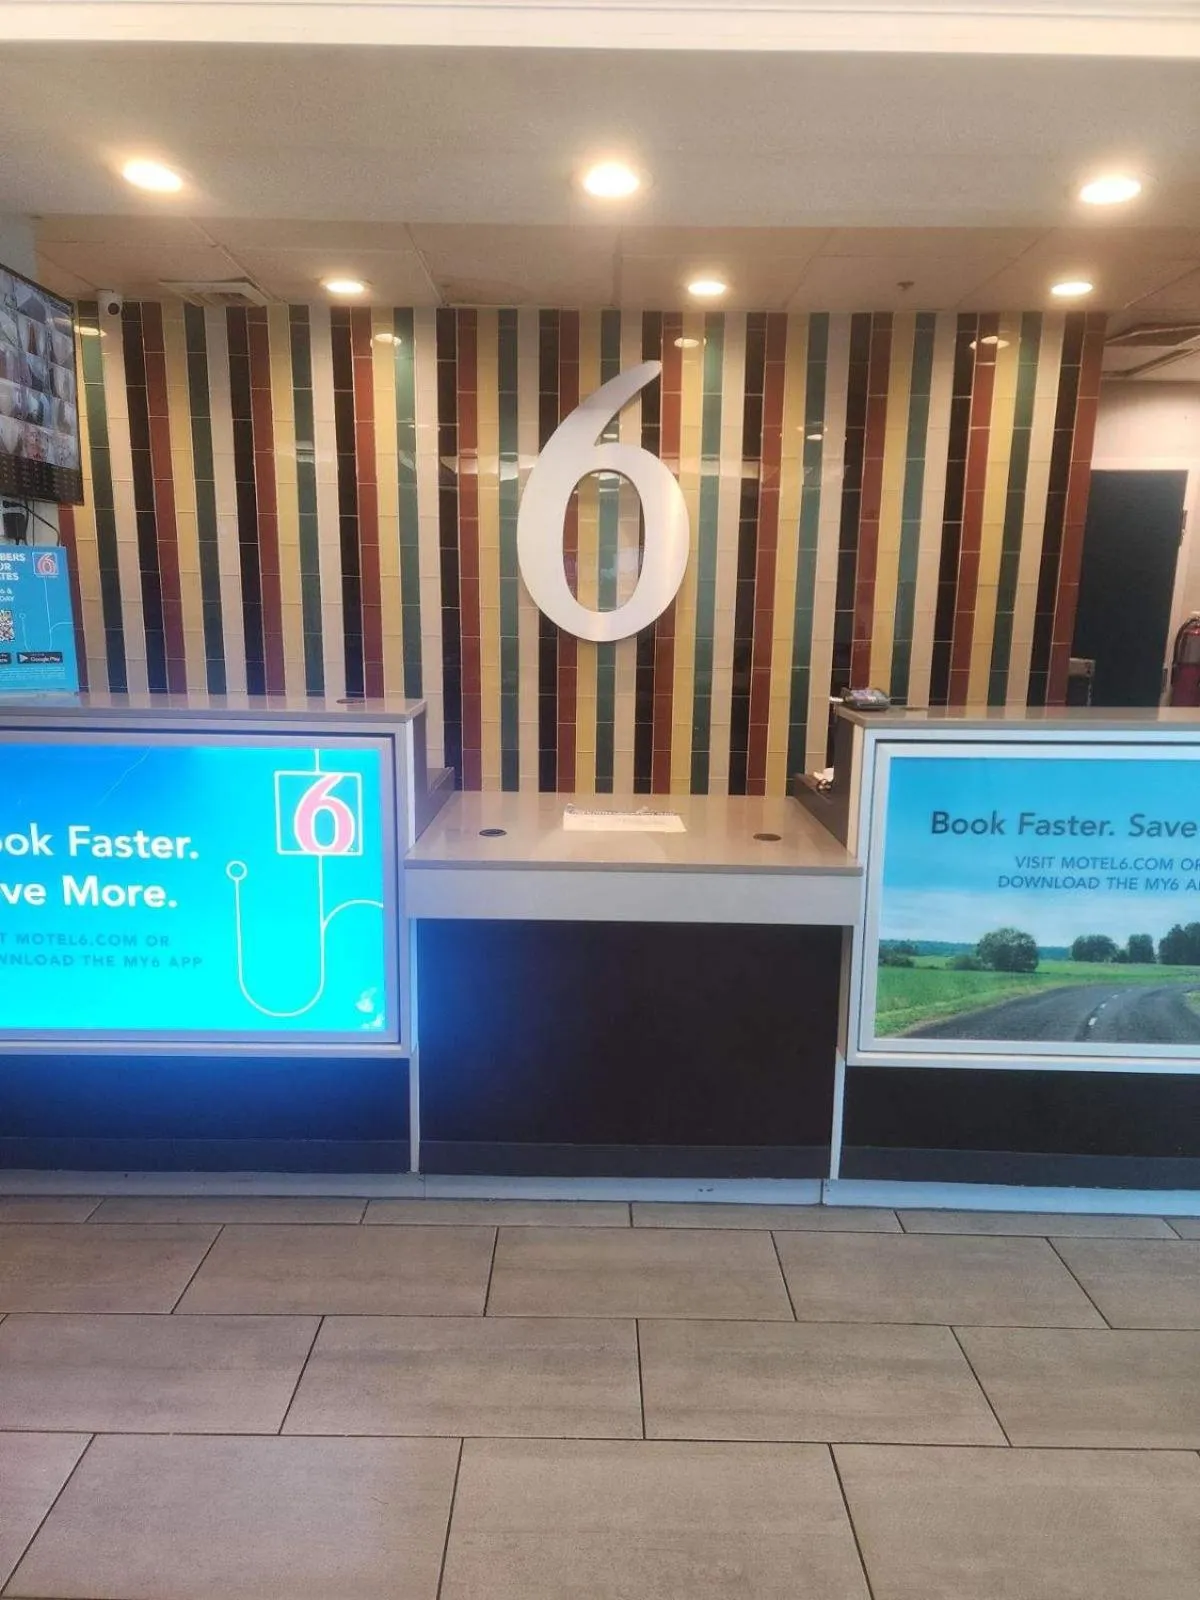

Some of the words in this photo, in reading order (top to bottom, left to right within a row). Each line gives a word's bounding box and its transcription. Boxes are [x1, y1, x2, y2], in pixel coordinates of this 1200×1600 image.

[517, 360, 690, 642] 6
[37, 553, 56, 575] 6
[293, 773, 355, 855] 6
[931, 810, 1007, 836] Book
[1018, 812, 1115, 837] Faster.
[1128, 813, 1198, 838] Save
[0, 822, 55, 857] ok
[68, 824, 200, 860] Faster.
[1014, 856, 1056, 870] VISIT
[1061, 856, 1174, 871] MOTEL6.COM
[62, 875, 178, 908] More.
[998, 875, 1101, 890] DOWNLOAD
[1107, 877, 1139, 891] THE
[1145, 877, 1180, 892] MY6
[1185, 878, 1200, 892] A
[15, 932, 138, 947] MOTEL6.COM
[145, 935, 171, 948] OR
[81, 955, 116, 968] THE
[123, 956, 161, 969] MY6
[169, 956, 203, 969] APP
